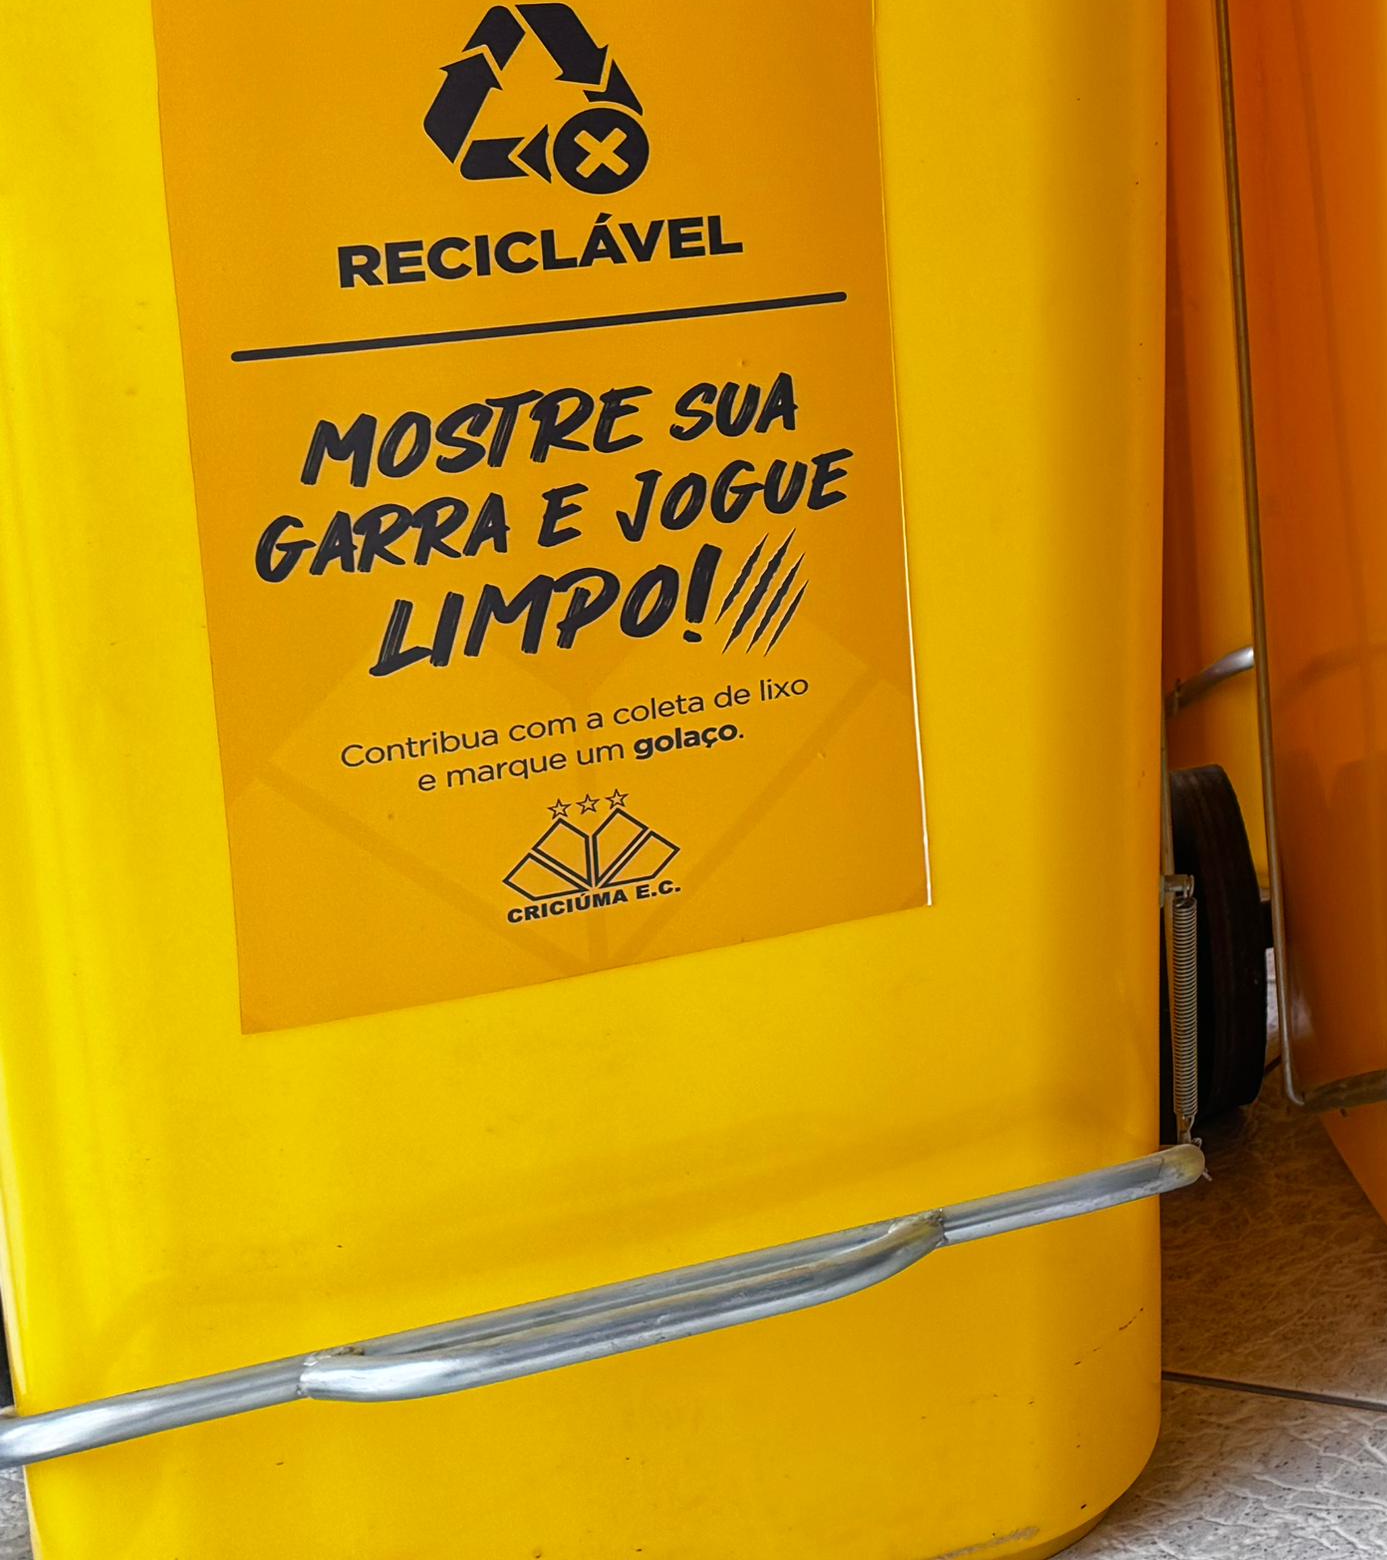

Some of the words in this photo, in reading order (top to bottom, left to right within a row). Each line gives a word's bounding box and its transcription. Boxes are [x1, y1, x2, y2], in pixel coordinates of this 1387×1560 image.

[337, 213, 743, 289] RECICLÁVEL
[299, 384, 654, 489] MOSTRE
[669, 371, 800, 442] SUA
[254, 491, 511, 584] GARRA
[536, 483, 590, 549] E
[616, 448, 854, 543] JOGUE
[368, 543, 723, 678] LIMPO!
[339, 725, 499, 770] Contribua
[508, 714, 577, 745] com
[586, 711, 603, 731] a
[612, 690, 705, 728] coleta
[713, 684, 751, 711] de
[759, 676, 809, 701] lixo
[417, 770, 437, 793] e
[446, 751, 567, 790] marque
[576, 739, 624, 766] um
[633, 718, 745, 763] golaço.
[506, 888, 628, 924] CRICIÚMA
[635, 879, 682, 904] E.C.
